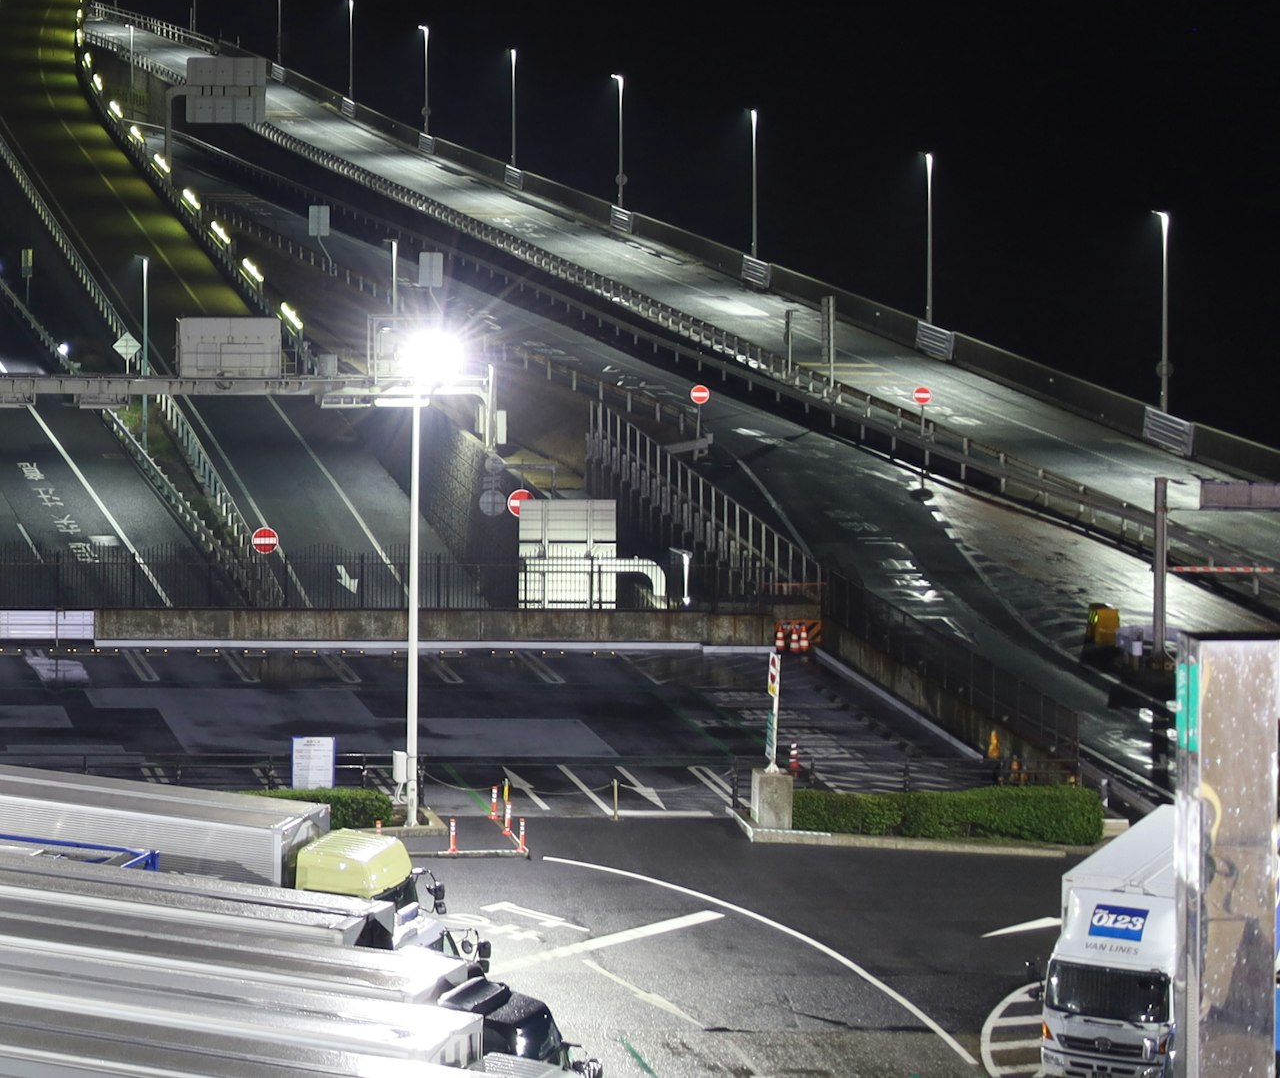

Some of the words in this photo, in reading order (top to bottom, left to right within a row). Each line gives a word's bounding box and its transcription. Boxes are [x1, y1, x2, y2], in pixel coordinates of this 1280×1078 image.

[1092, 912, 1145, 931] 0123
[1085, 942, 1107, 952] VAN
[1109, 944, 1139, 955] LINES
